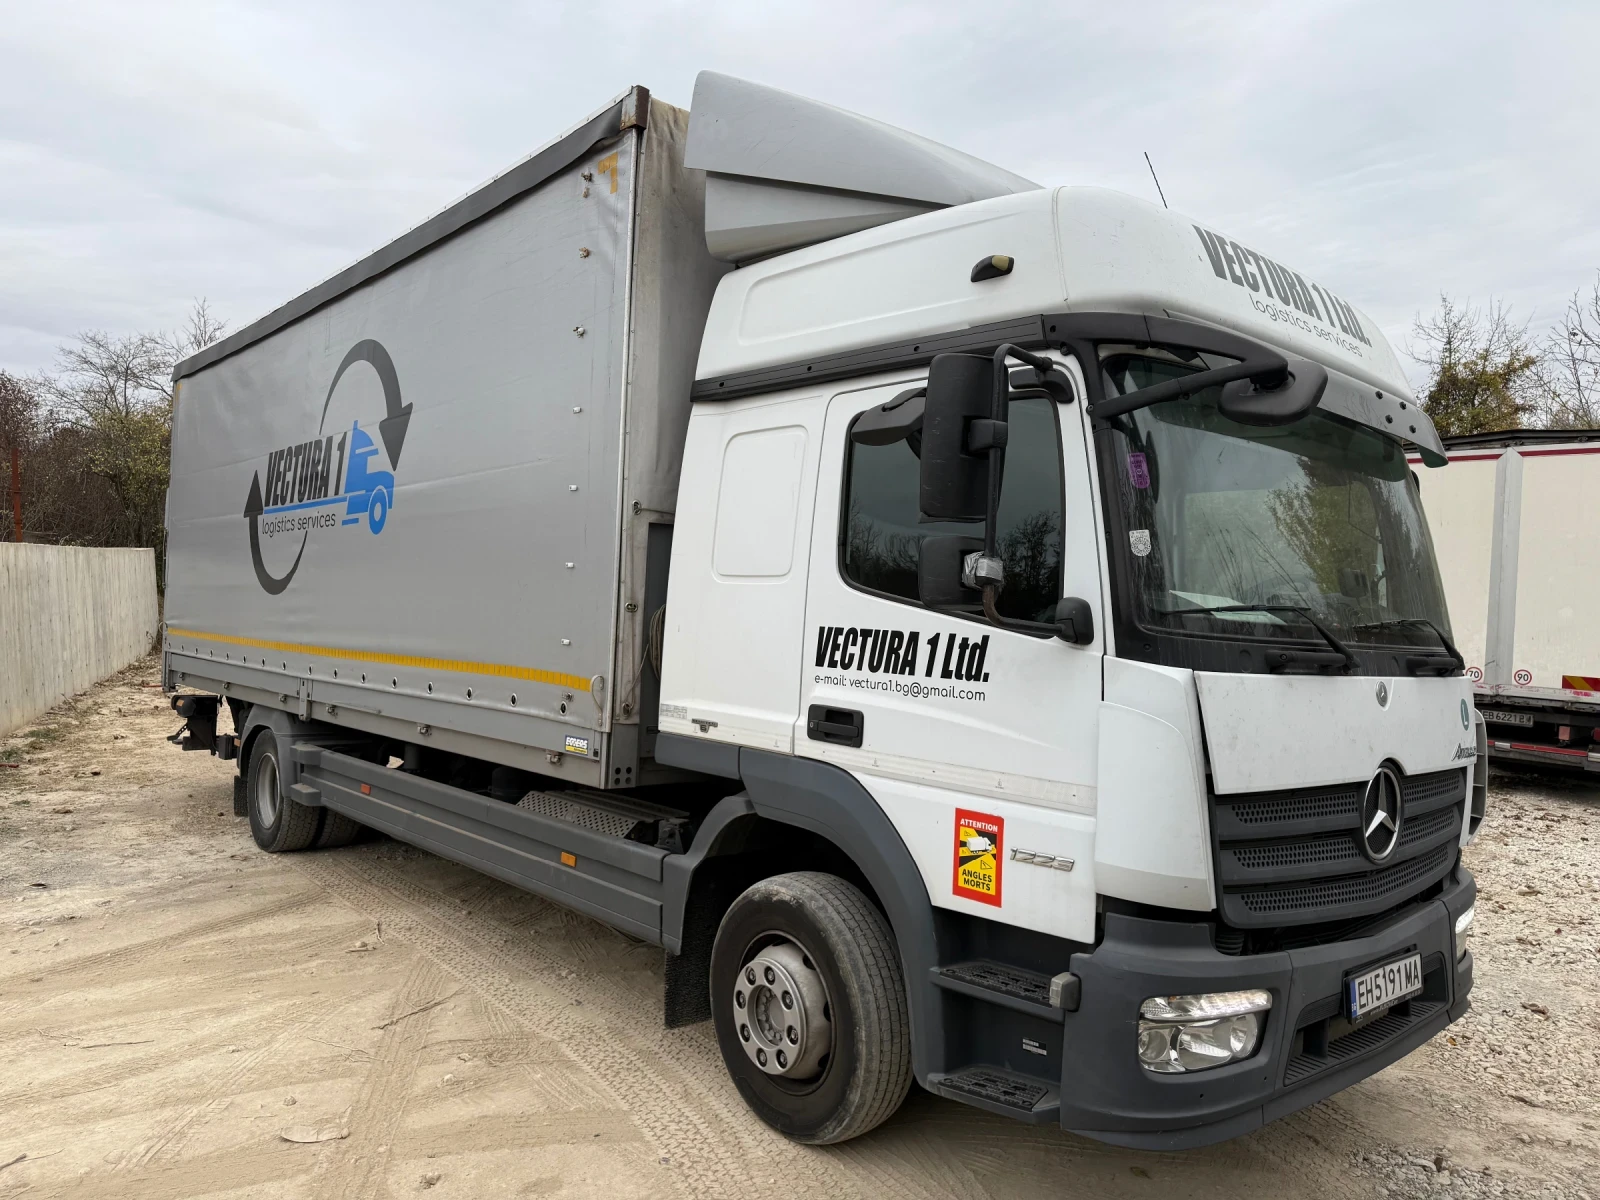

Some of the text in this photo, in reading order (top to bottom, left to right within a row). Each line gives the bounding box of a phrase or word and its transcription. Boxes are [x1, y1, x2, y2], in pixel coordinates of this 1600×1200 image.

[1191, 224, 1372, 348] VECTURA 1 Ltd.
[1249, 293, 1362, 357] logistics services
[264, 431, 347, 507] VECTURA 1
[262, 511, 336, 538] logistics services
[815, 626, 990, 682] VECTURA 1 Ltd.
[814, 674, 986, 702] e-mail: vectura1.bg@gmail.com
[1469, 670, 1480, 679] 70
[1517, 673, 1529, 682] 90
[960, 818, 998, 833] ATTENTION
[962, 868, 992, 883] ANGLES
[963, 877, 991, 891] MORTS
